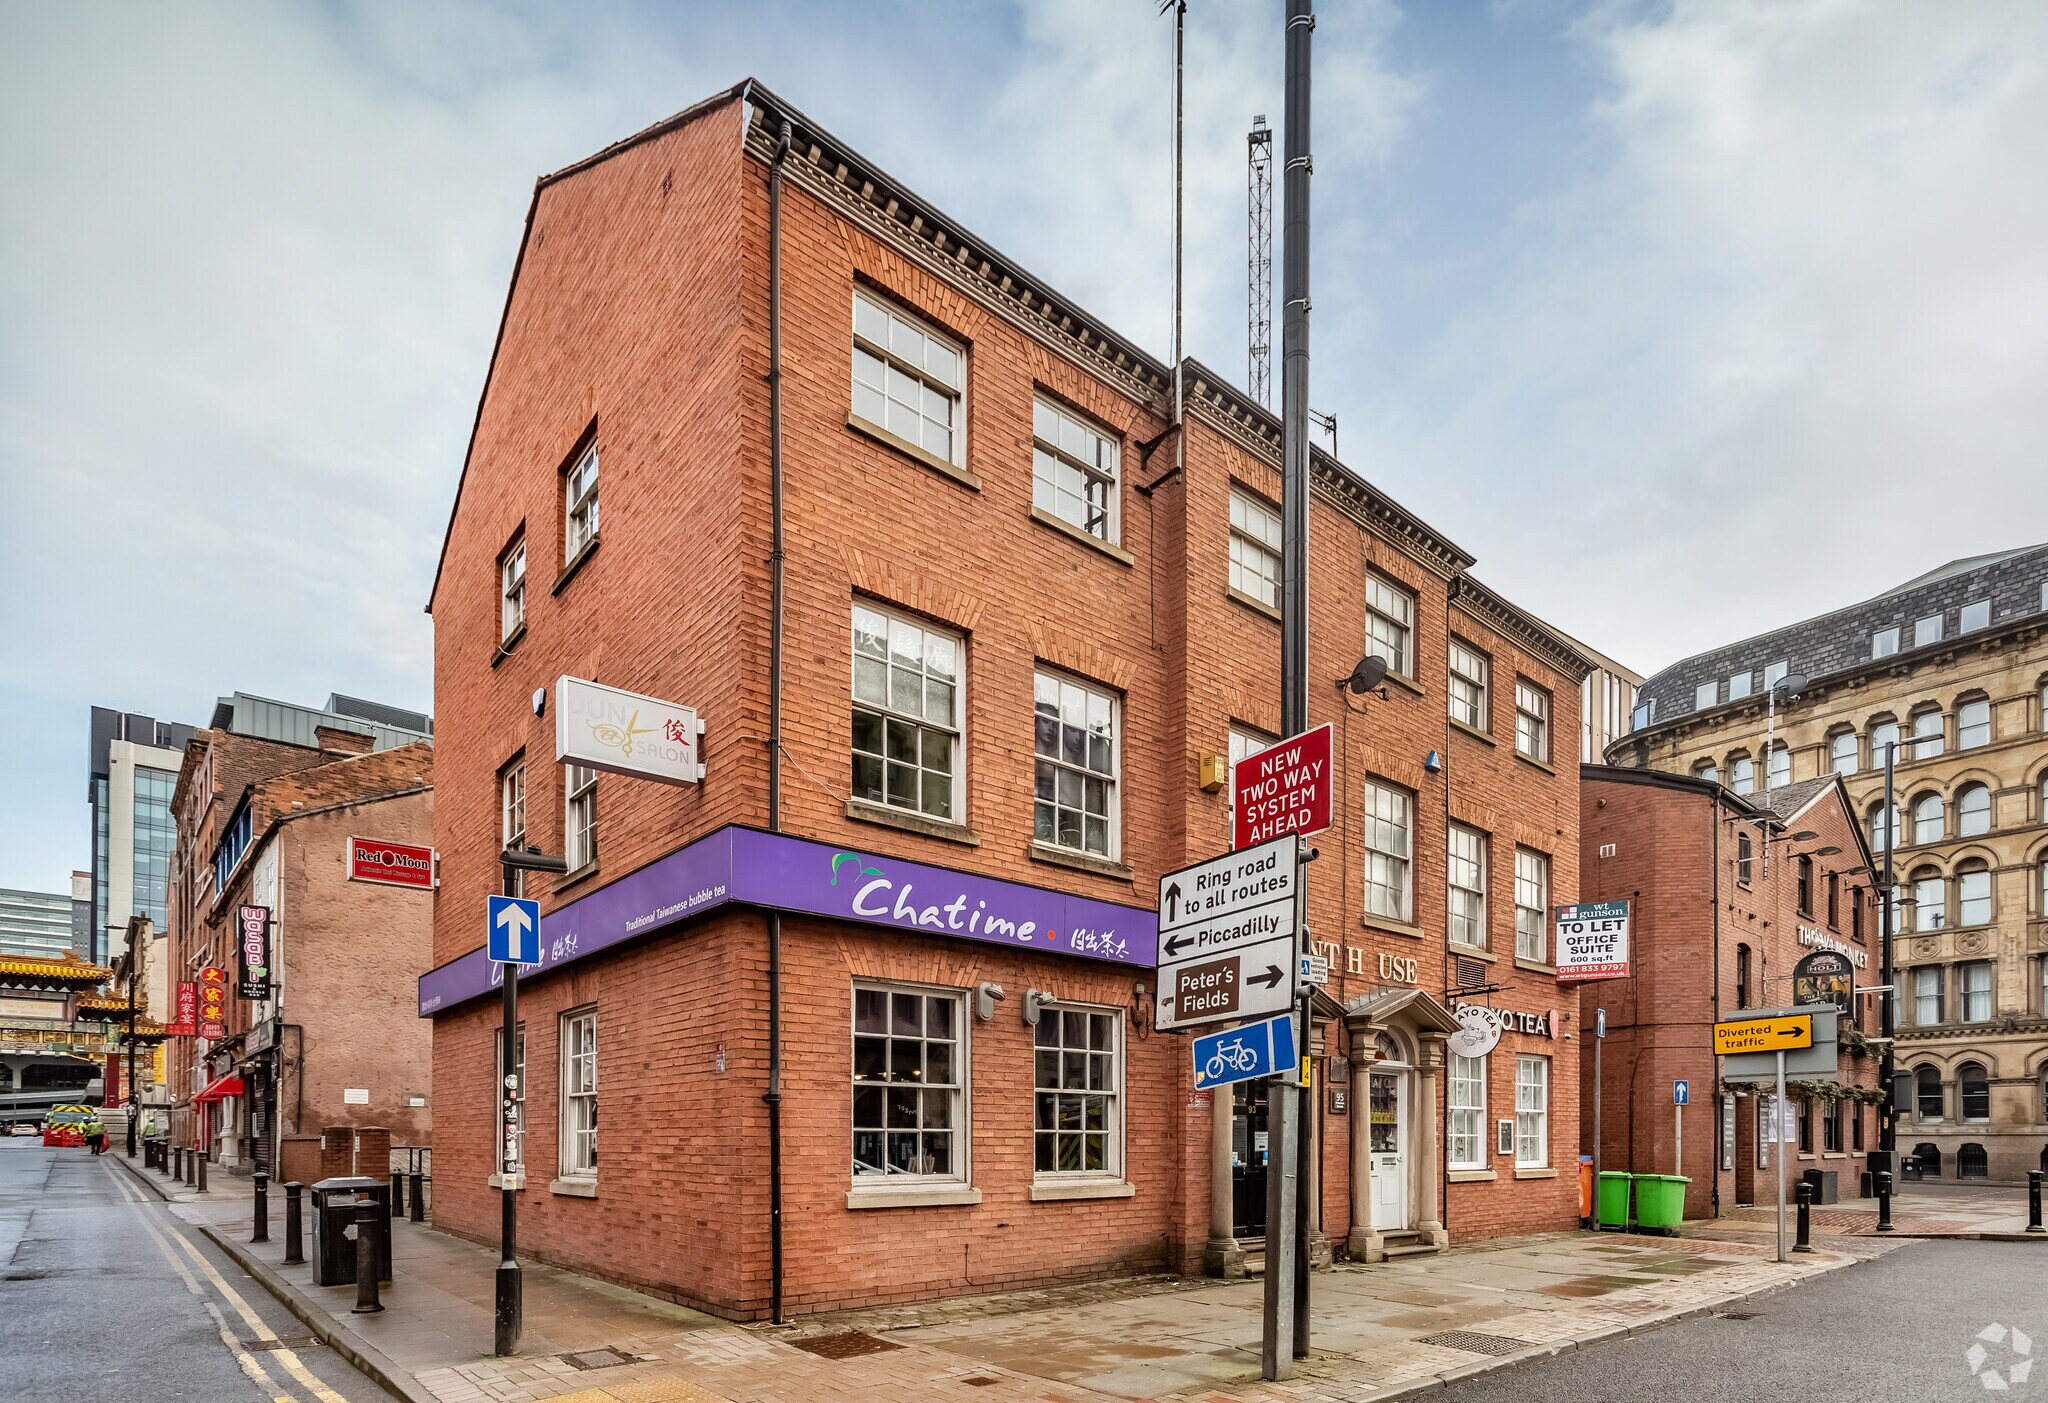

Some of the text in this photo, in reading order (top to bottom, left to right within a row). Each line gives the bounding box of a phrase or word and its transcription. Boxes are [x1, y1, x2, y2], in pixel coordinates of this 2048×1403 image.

[572, 694, 626, 725] JUN
[662, 719, 690, 746] 俊
[636, 741, 689, 764] SALON
[1261, 746, 1302, 778] NEW
[1241, 759, 1323, 805] TWO WAY
[1247, 784, 1315, 823] SYSTEM
[1250, 808, 1312, 843] AHEAD
[356, 848, 429, 870] Red Moon
[1197, 852, 1276, 891] Ring road
[1185, 874, 1288, 915] to all routes
[1593, 902, 1609, 910] wt
[625, 885, 726, 932] Traditional Taiwanese bubble tea
[852, 879, 1036, 941] Chatime
[1579, 909, 1623, 920] gunson
[1199, 914, 1280, 947] Piccadilly
[1560, 920, 1625, 934] TO LET
[1566, 934, 1618, 945] OFFICE
[1570, 944, 1613, 954] SUITE
[1181, 965, 1234, 993] Peter's
[1378, 953, 1418, 984] USE
[1560, 971, 1625, 979] www.wtgunson.co.uk
[1809, 964, 1837, 972] HOLT
[1183, 991, 1229, 1013] Fields
[1482, 1011, 1496, 1028] TEA
[1516, 1011, 1545, 1035] TEA
[1718, 1025, 1771, 1038] Diverted
[1725, 1038, 1765, 1048] traffic
[1336, 1092, 1344, 1101] 95
[1248, 1105, 1256, 1113] 93
